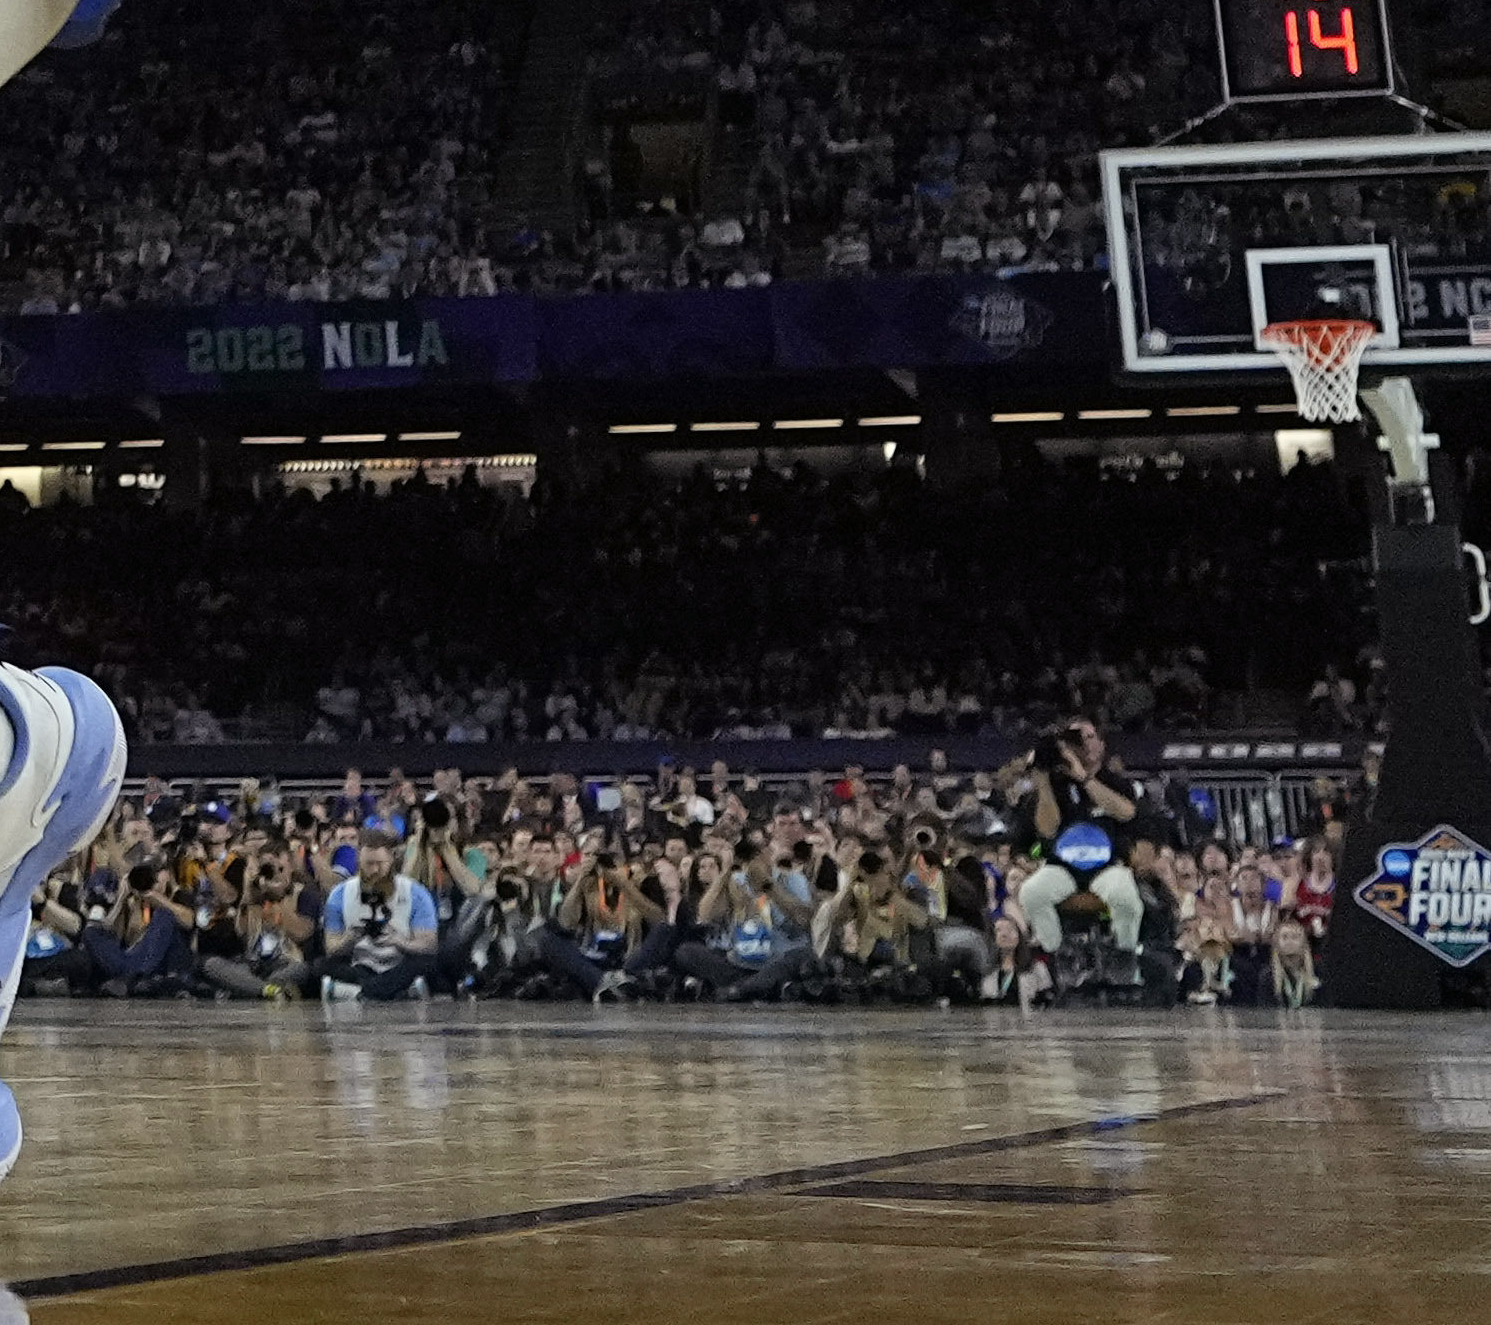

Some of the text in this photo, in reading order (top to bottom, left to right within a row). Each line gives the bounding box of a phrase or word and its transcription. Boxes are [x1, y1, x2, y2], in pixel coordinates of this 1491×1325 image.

[1285, 7, 1359, 78] 14
[186, 319, 449, 374] 2022 NOLA
